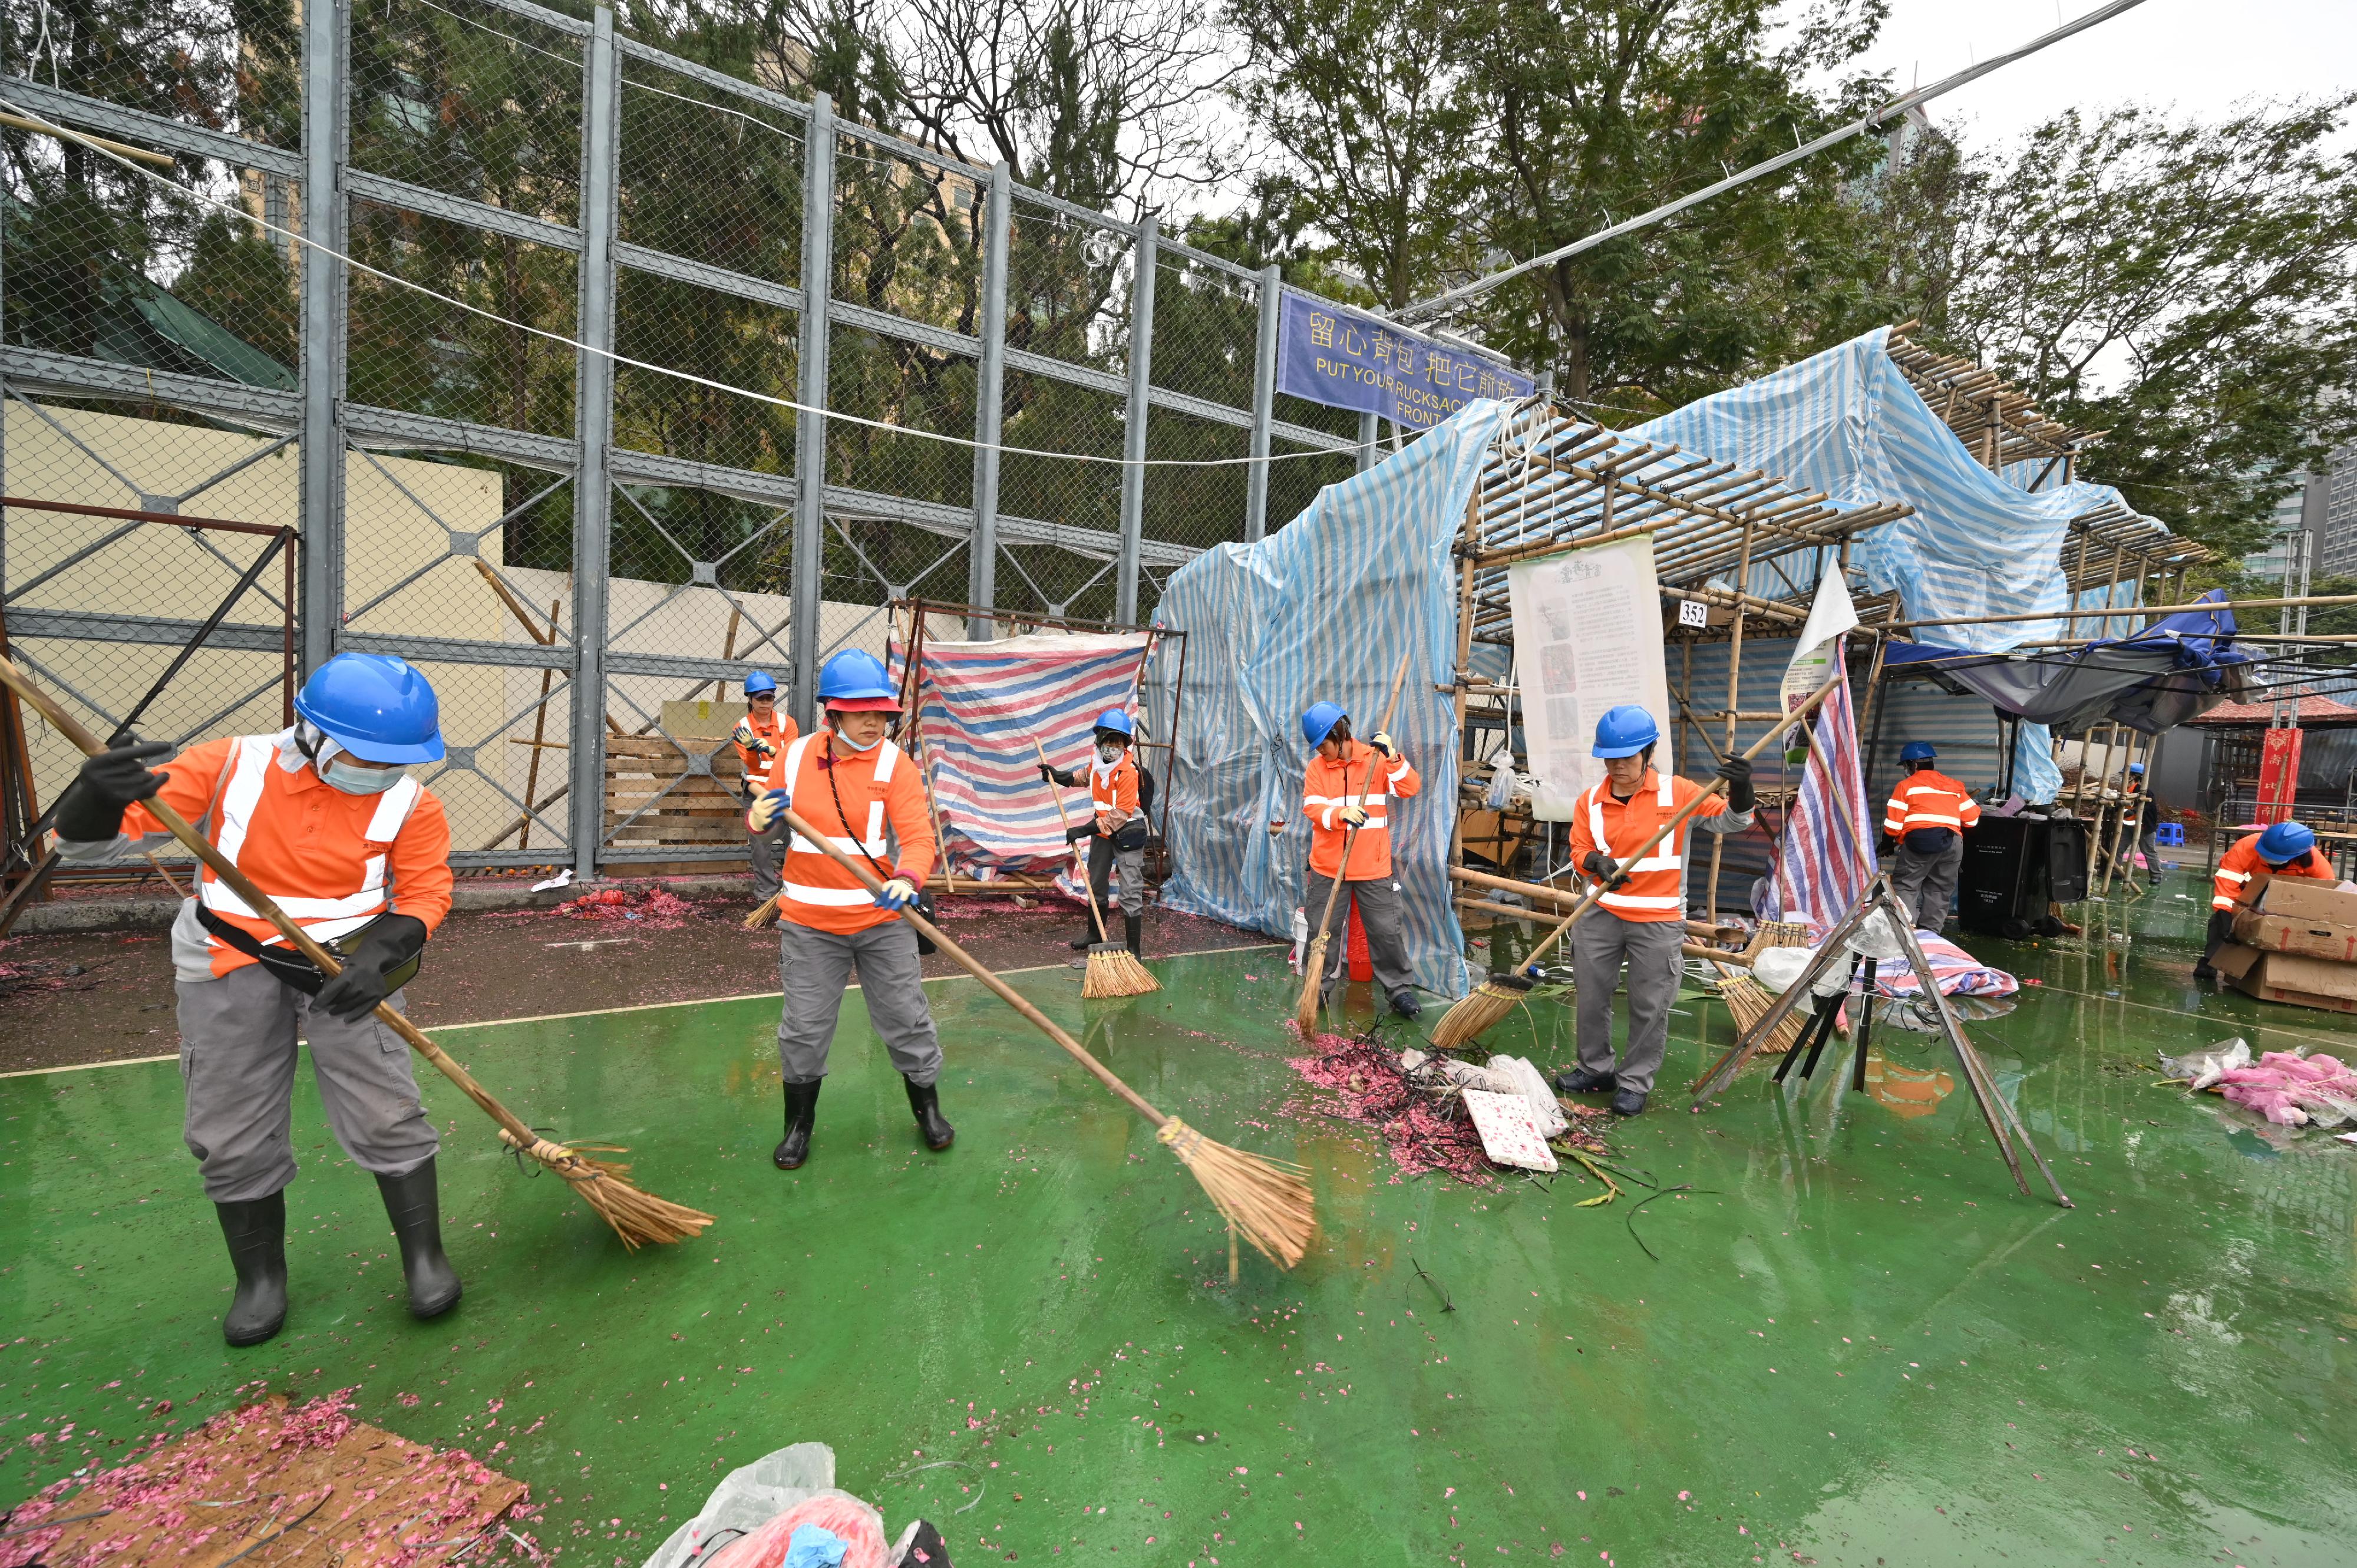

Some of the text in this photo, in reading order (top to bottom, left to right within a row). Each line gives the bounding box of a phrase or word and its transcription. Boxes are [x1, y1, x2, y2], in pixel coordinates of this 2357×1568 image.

[1310, 312, 1515, 402] 留心背包 把它前放
[1316, 358, 1465, 414] PUT YOUR RUCKSAC
[1397, 401, 1441, 425] FRONT
[1682, 604, 1704, 623] 352
